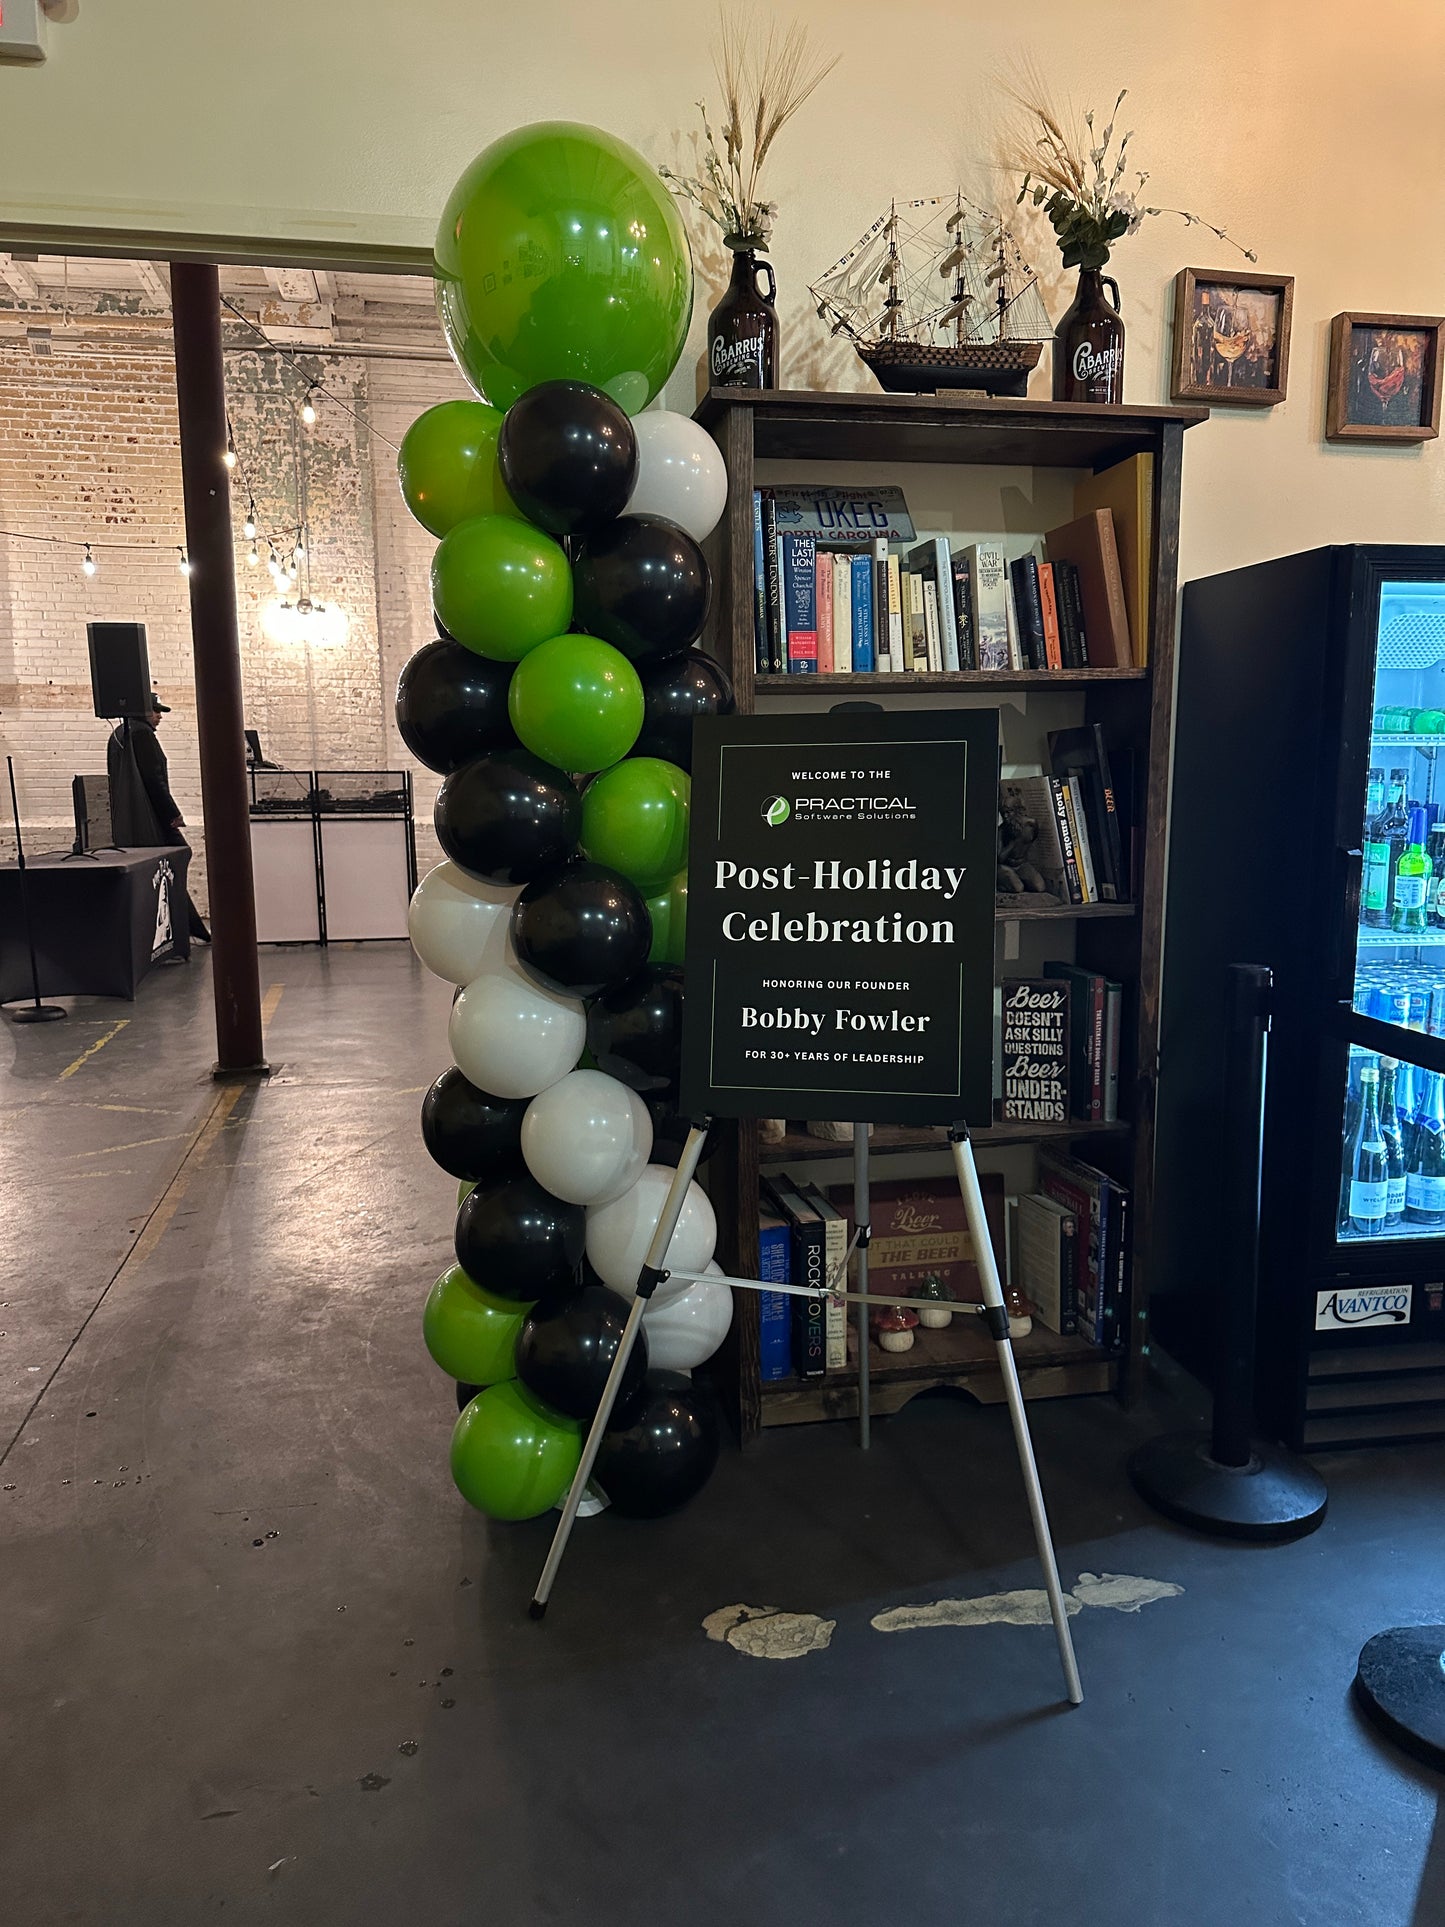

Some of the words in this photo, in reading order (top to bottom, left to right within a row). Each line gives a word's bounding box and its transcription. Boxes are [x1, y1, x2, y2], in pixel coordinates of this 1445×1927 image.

[712, 335, 764, 376] CABARRUS
[768, 522, 776, 556] TOWER
[794, 539, 810, 548] THE
[828, 529, 900, 540] CAROLINA
[792, 548, 812, 557] LAST
[979, 551, 1000, 561] CIVIL
[792, 558, 812, 567] LION
[769, 563, 778, 606] LONDON
[792, 770, 846, 780] WELCOME
[850, 770, 866, 780] TO
[869, 769, 891, 780] THE
[795, 797, 916, 810] PRACTICAL
[1055, 792, 1066, 818] holy
[857, 812, 916, 820] Solutions
[1060, 819, 1074, 858] smoke
[715, 859, 966, 899] Post-Holiday
[722, 911, 955, 944] Celebration
[762, 980, 824, 989] HONORING
[828, 980, 851, 990] OUR
[855, 981, 910, 991] FOUNDER
[1005, 986, 1066, 1009] Beer
[741, 1007, 826, 1036] Bobby
[835, 1008, 930, 1032] Fowler
[1006, 1011, 1064, 1027] DOESN'T
[1005, 1027, 1030, 1041] ASK
[1032, 1028, 1063, 1042] SILLY
[745, 1050, 767, 1059] FOR
[770, 1051, 790, 1060] 30+
[794, 1051, 830, 1061] YEARS
[834, 1052, 848, 1062] OF
[852, 1053, 924, 1064] LEADERSHIP
[1004, 1042, 1063, 1056] QUESTIONS
[1005, 1055, 1066, 1078] Beer
[1006, 1079, 1067, 1100] UNDER-
[1005, 1100, 1065, 1122] STANDS
[890, 1206, 943, 1233] Beer
[887, 1239, 916, 1250] THAT
[920, 1236, 959, 1247] COULD
[880, 1251, 912, 1264] THE
[916, 1247, 960, 1260] BEER
[808, 1244, 820, 1288] ROCK
[891, 1269, 951, 1281] TALKING
[1357, 1287, 1409, 1297] REFRIGERATION
[771, 1292, 784, 1321] OLMES
[1318, 1292, 1408, 1322] AVANTCO
[808, 1295, 821, 1357] COVERS
